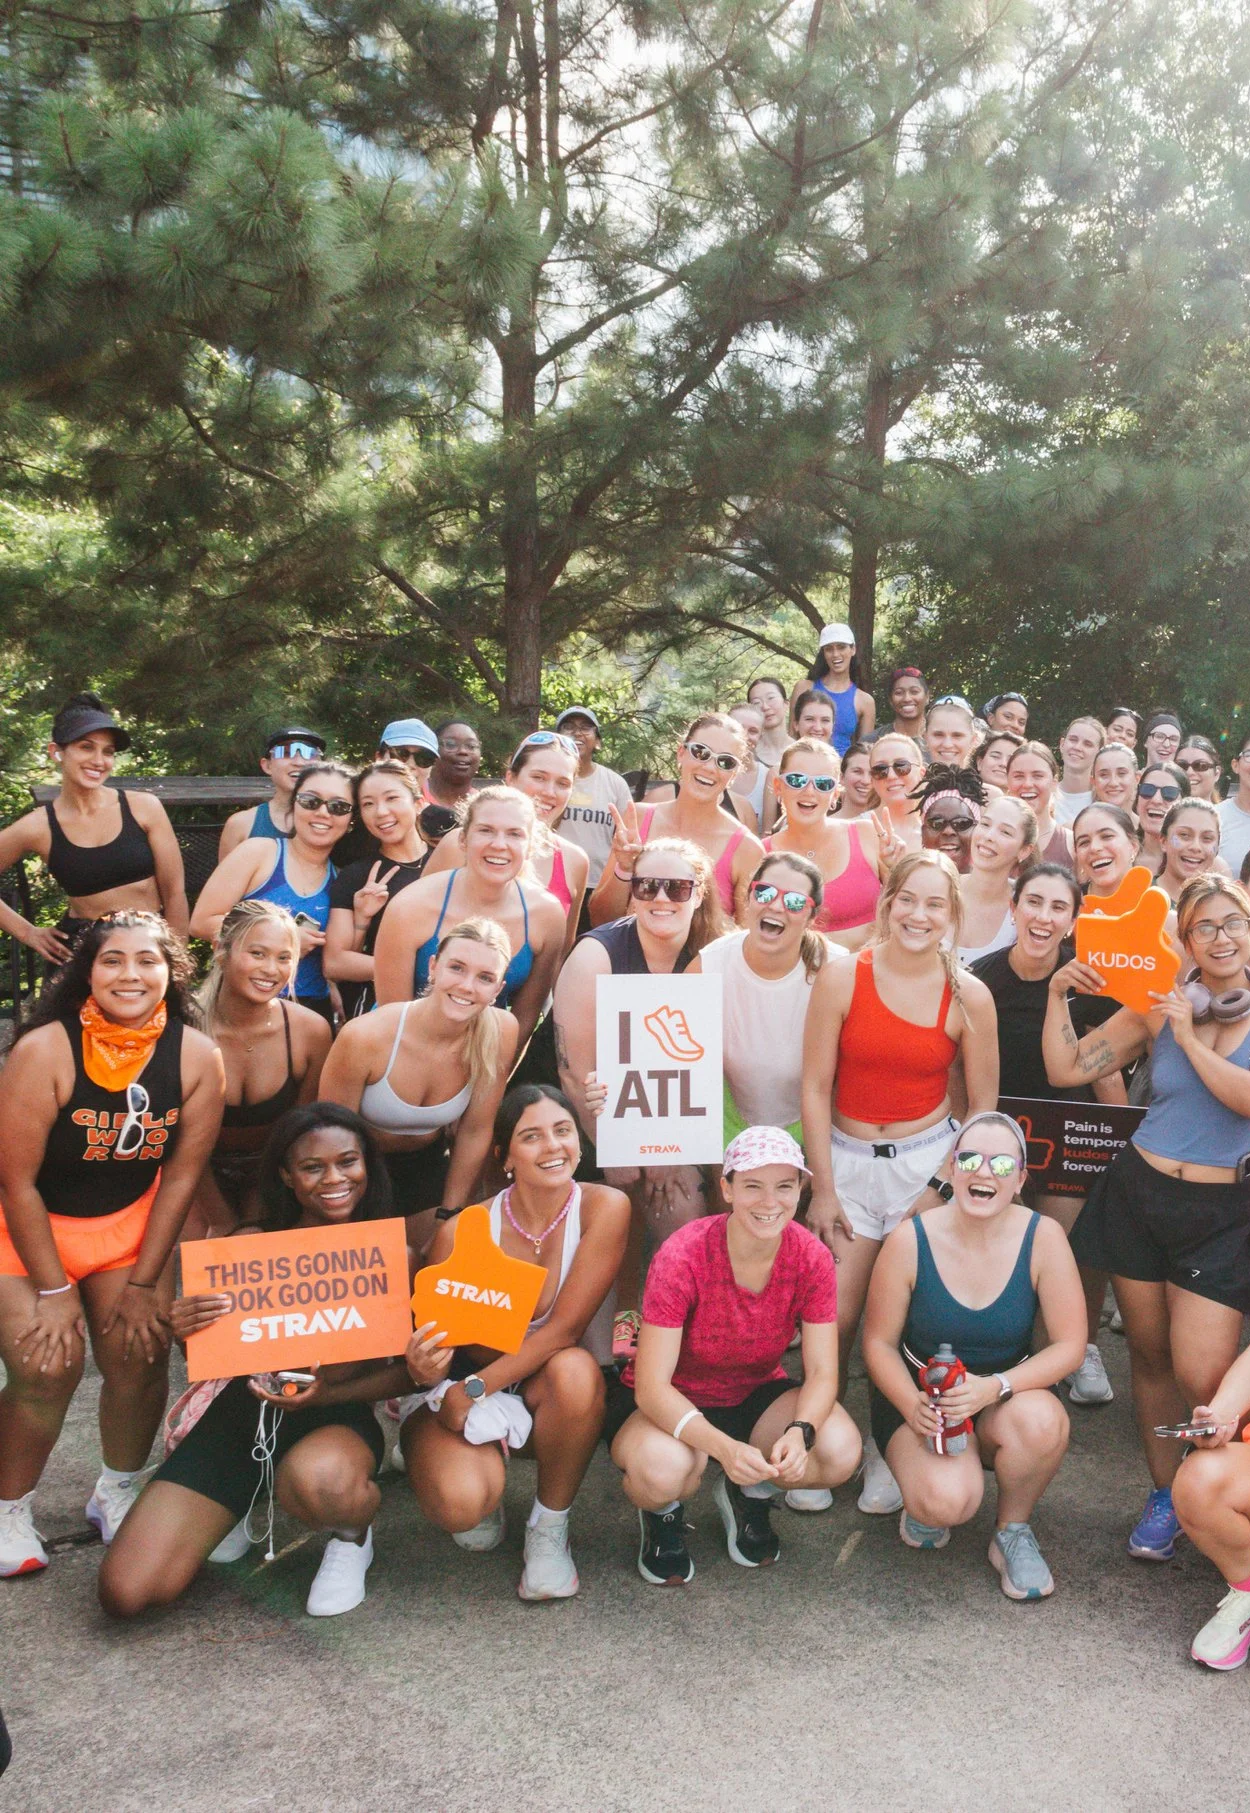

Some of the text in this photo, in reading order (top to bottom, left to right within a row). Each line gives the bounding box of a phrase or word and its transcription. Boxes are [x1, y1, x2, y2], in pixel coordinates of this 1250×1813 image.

[1087, 951, 1157, 971] KUDOS
[618, 1011, 631, 1064] I
[613, 1069, 706, 1118] ATL
[87, 1127, 169, 1146] WO
[1064, 1120, 1113, 1134] Pain is
[639, 1144, 682, 1154] STRAVA
[1063, 1146, 1109, 1160] kudos
[204, 1246, 386, 1288] THIS IS GONNA
[222, 1273, 389, 1314] OOK GOOD ON
[434, 1278, 512, 1311] STRAVA
[240, 1305, 367, 1343] STRAVA
